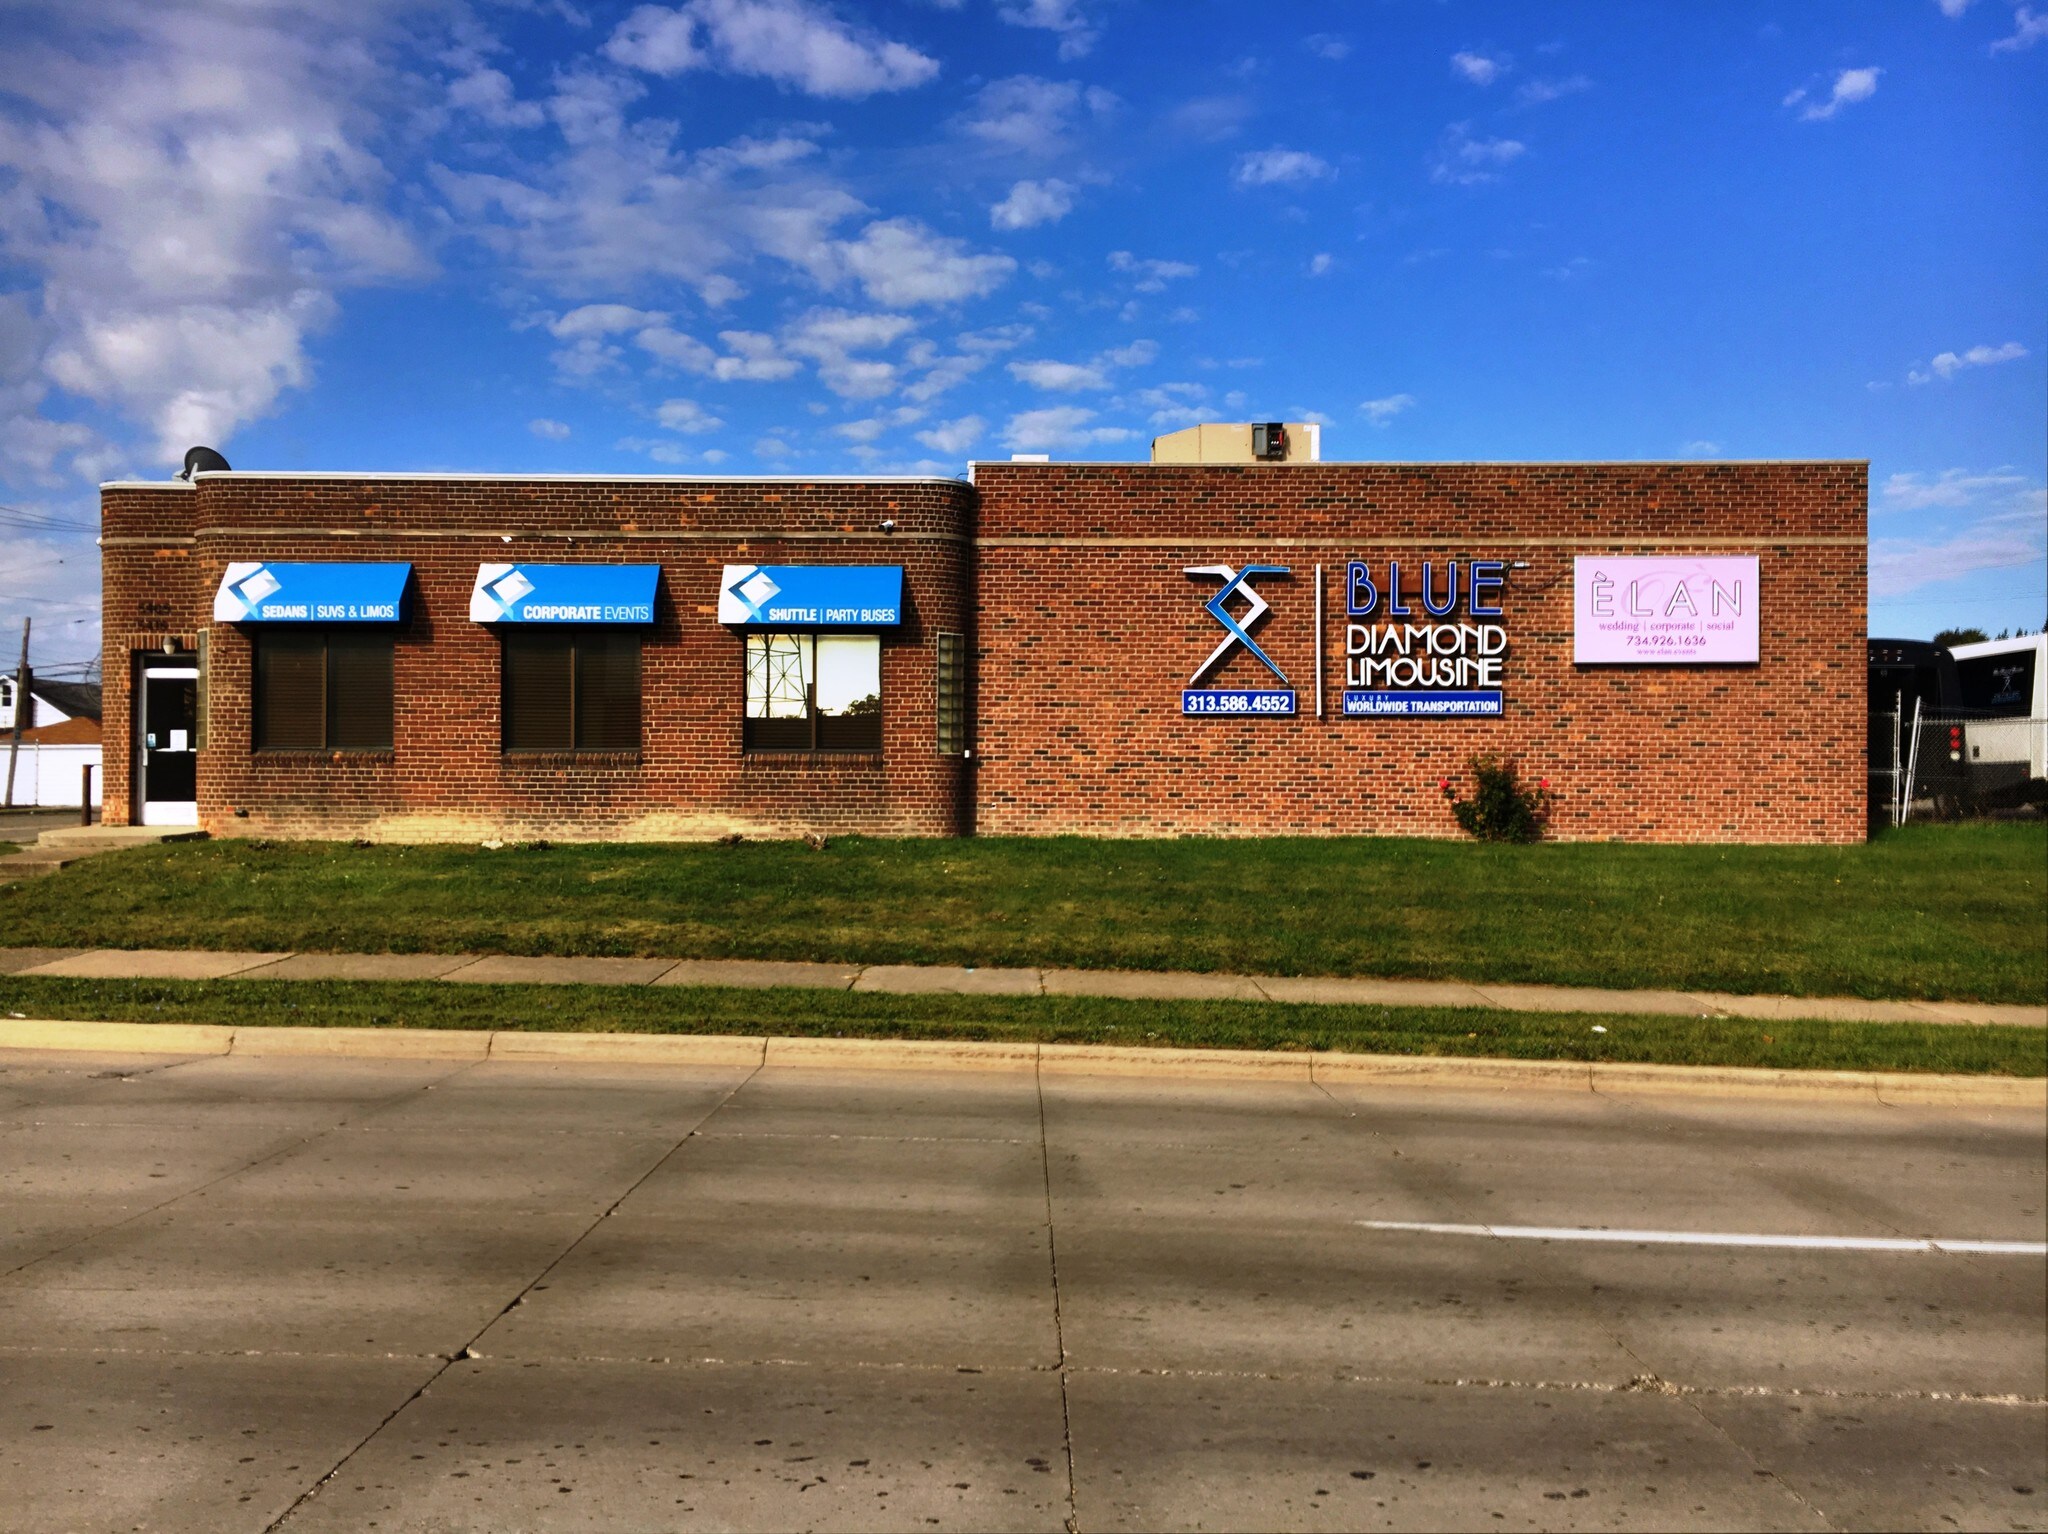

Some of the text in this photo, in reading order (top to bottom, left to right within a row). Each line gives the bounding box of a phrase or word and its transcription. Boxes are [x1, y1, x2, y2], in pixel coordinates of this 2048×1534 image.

[1347, 561, 1503, 616] BLUE
[262, 605, 394, 618] SEDANS SUVS & LIMOS
[523, 605, 649, 620] CORPORATE EVENTS
[769, 608, 895, 622] SHUTTLE PARTY BUSES
[1599, 620, 1734, 632] wedding corporate social
[1347, 623, 1507, 655] DIAMOND
[1347, 657, 1503, 687] LIMOUSINE
[1187, 695, 1290, 712] 313.586.4552
[1347, 700, 1499, 713] WORLDWIDE TRANSPORTATION
